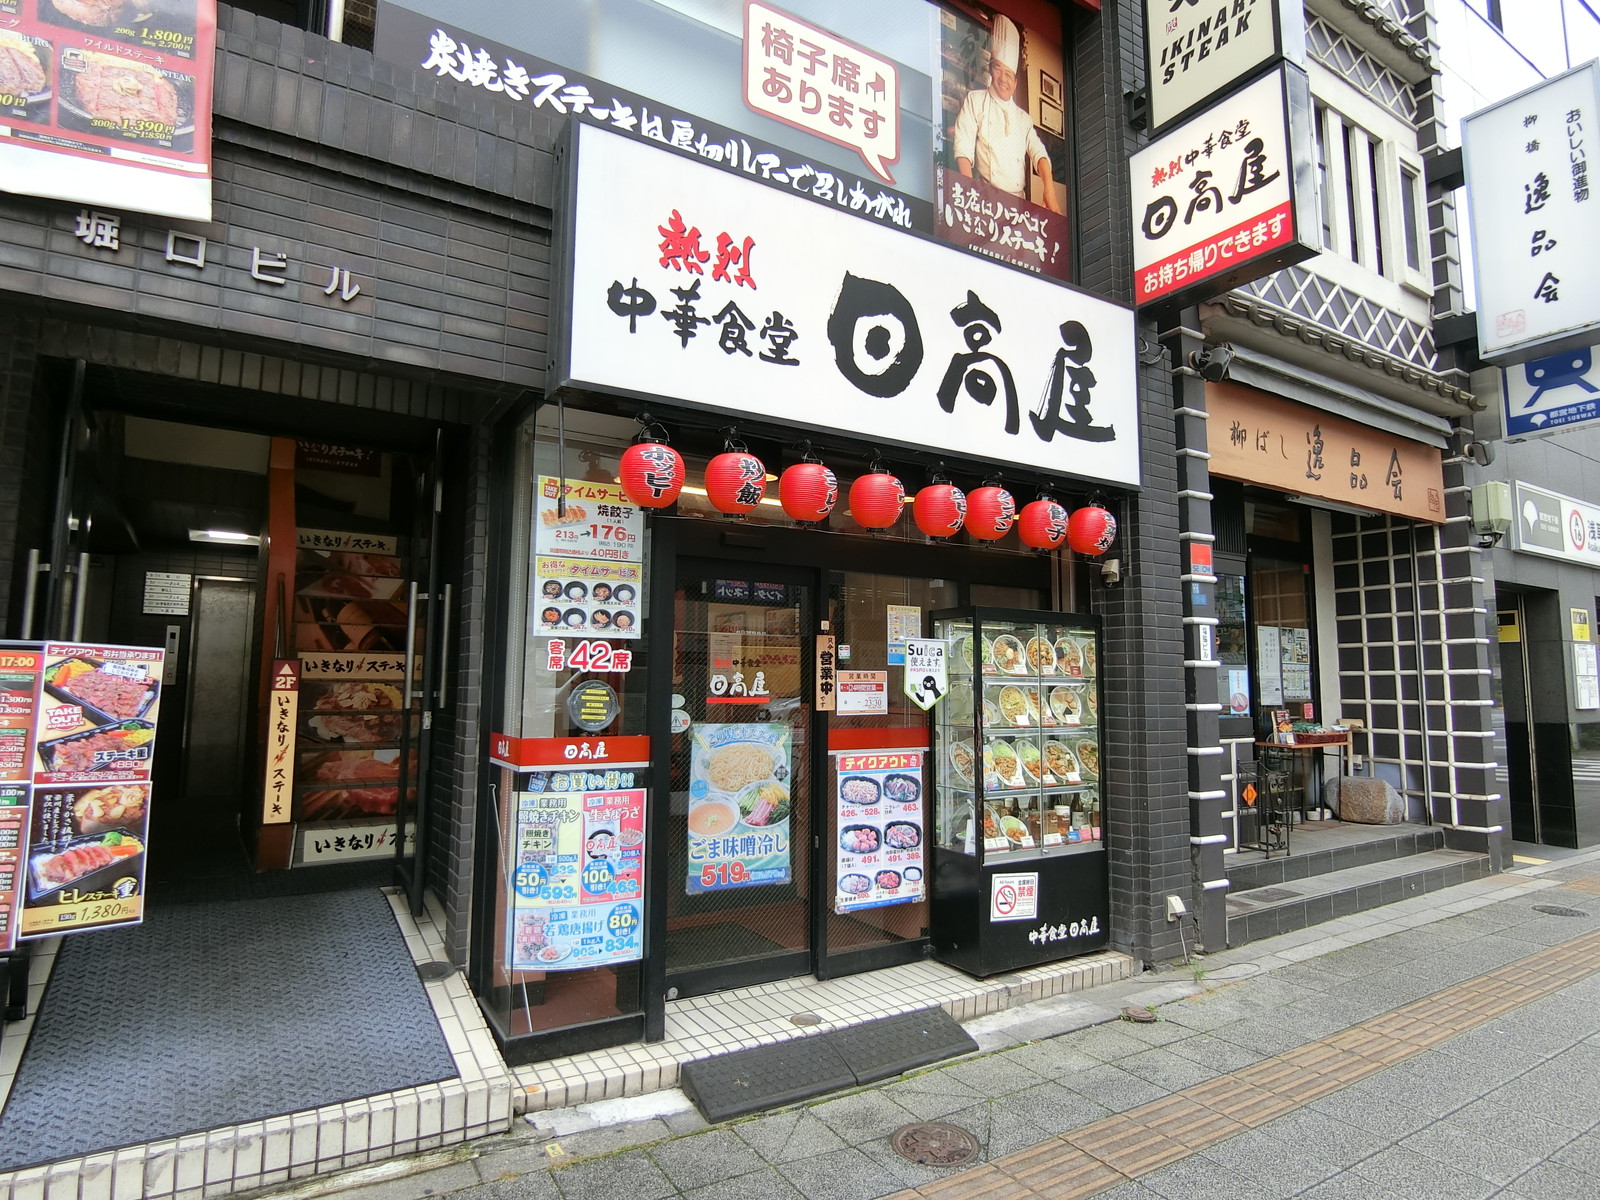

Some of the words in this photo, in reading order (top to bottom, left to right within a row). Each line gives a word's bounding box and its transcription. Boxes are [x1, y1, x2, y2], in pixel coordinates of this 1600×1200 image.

[114, 27, 136, 37] 200g
[139, 27, 194, 44] 1,800円
[83, 37, 166, 65] ワイルドステーキ
[1163, 10, 1252, 85] STEAK
[761, 22, 861, 94] 椅子席
[761, 67, 886, 139] あります
[91, 119, 116, 129] 300g
[121, 119, 176, 134] 1,390円
[1565, 108, 1590, 204] おいしい御進物
[1141, 137, 1281, 241] 日高屋
[75, 209, 361, 301] 堀口ビル
[657, 209, 757, 290] 熱烈
[1143, 212, 1287, 294] お持ち帰りできます
[607, 278, 801, 368] 中華食堂
[827, 270, 1117, 443] 日高屋
[1549, 402, 1597, 419] 都営地下鉄
[1549, 417, 1566, 426] TOEI
[1567, 410, 1598, 423] SUBWAY
[640, 446, 676, 499] ホッピー
[736, 457, 767, 507] 炒飯
[597, 504, 634, 519] 焼餃子
[1574, 516, 1580, 528] A
[590, 523, 636, 543] 176円
[1574, 528, 1583, 541] 16
[541, 560, 567, 569] お得な
[570, 564, 639, 579] タイムサービス
[549, 640, 565, 671] 客席
[907, 643, 944, 657] Suica
[819, 650, 834, 696] 営業中
[275, 676, 297, 689] 2F
[709, 671, 770, 697] 日高屋
[51, 714, 79, 724] OUT
[95, 748, 149, 763] ステーキ重
[564, 741, 609, 759] 日高屋
[845, 756, 908, 770] テイクアウト
[552, 771, 635, 791] お買い得!!
[605, 796, 630, 805] 業務用
[518, 810, 581, 824] 照焼きチキン
[589, 806, 641, 822] 生ぎょうざ
[523, 840, 552, 849] チキン
[690, 833, 788, 860] ごま味噌冷し
[516, 872, 547, 886] 50円
[581, 870, 613, 885] 100円
[701, 862, 750, 886] 519円
[58, 880, 137, 905] ヒレステーキ重
[540, 886, 577, 899] 593円
[1017, 886, 1034, 897] 禁煙
[544, 920, 604, 936] 若鶏唐揚げ
[609, 913, 638, 929] 80円
[1028, 922, 1068, 945] 中華食堂
[1070, 915, 1101, 938] 日高屋
